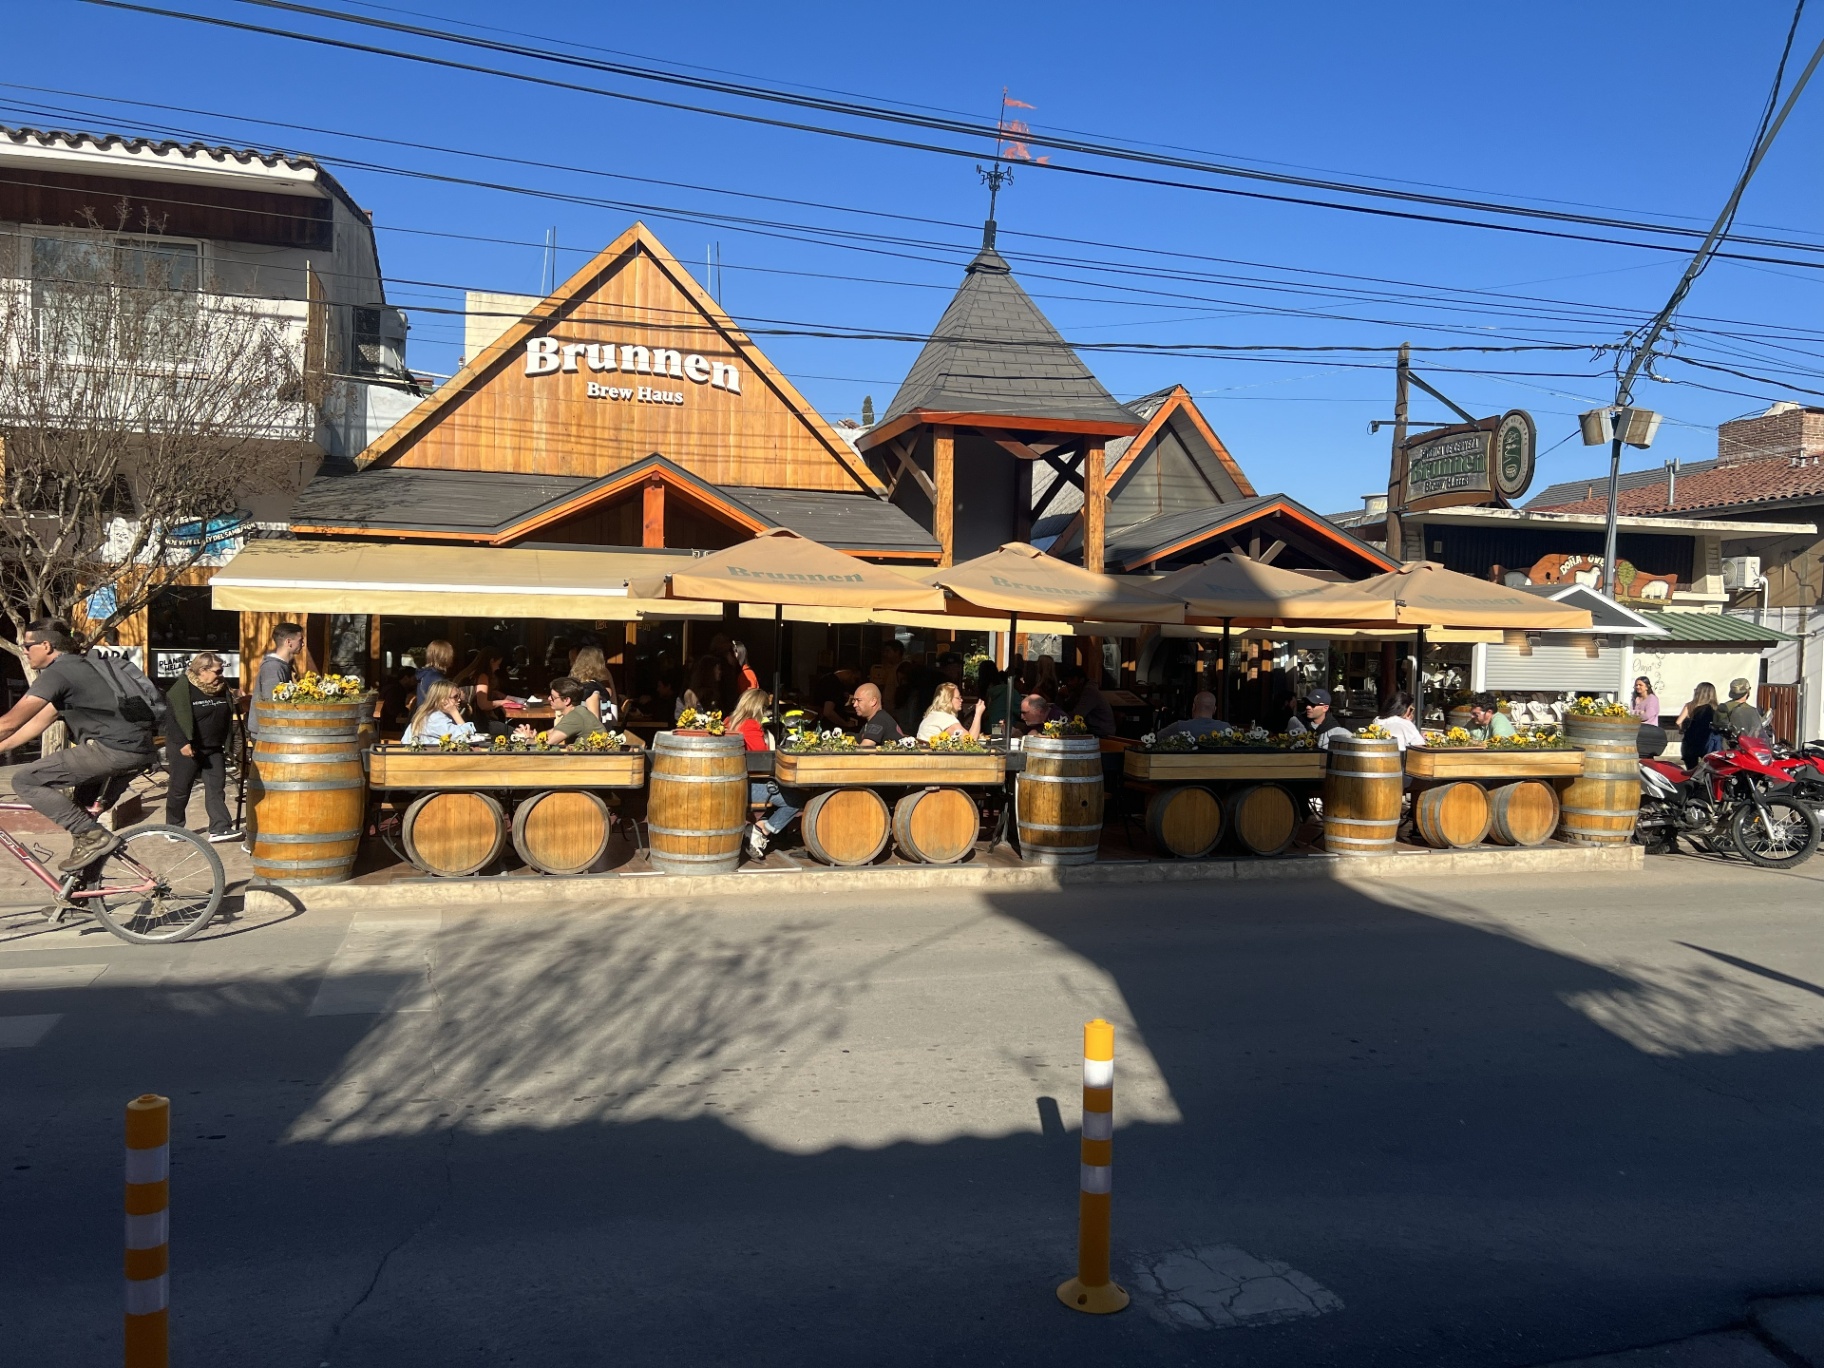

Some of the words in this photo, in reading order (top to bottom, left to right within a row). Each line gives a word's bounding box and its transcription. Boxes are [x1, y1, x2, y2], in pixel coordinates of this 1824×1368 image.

[524, 336, 741, 395] Brunnen
[587, 381, 633, 400] Brew
[637, 386, 684, 404] Haus
[1410, 453, 1486, 484] Brunnen
[726, 565, 864, 582] Brunnen
[1560, 555, 1582, 575] DOÑA
